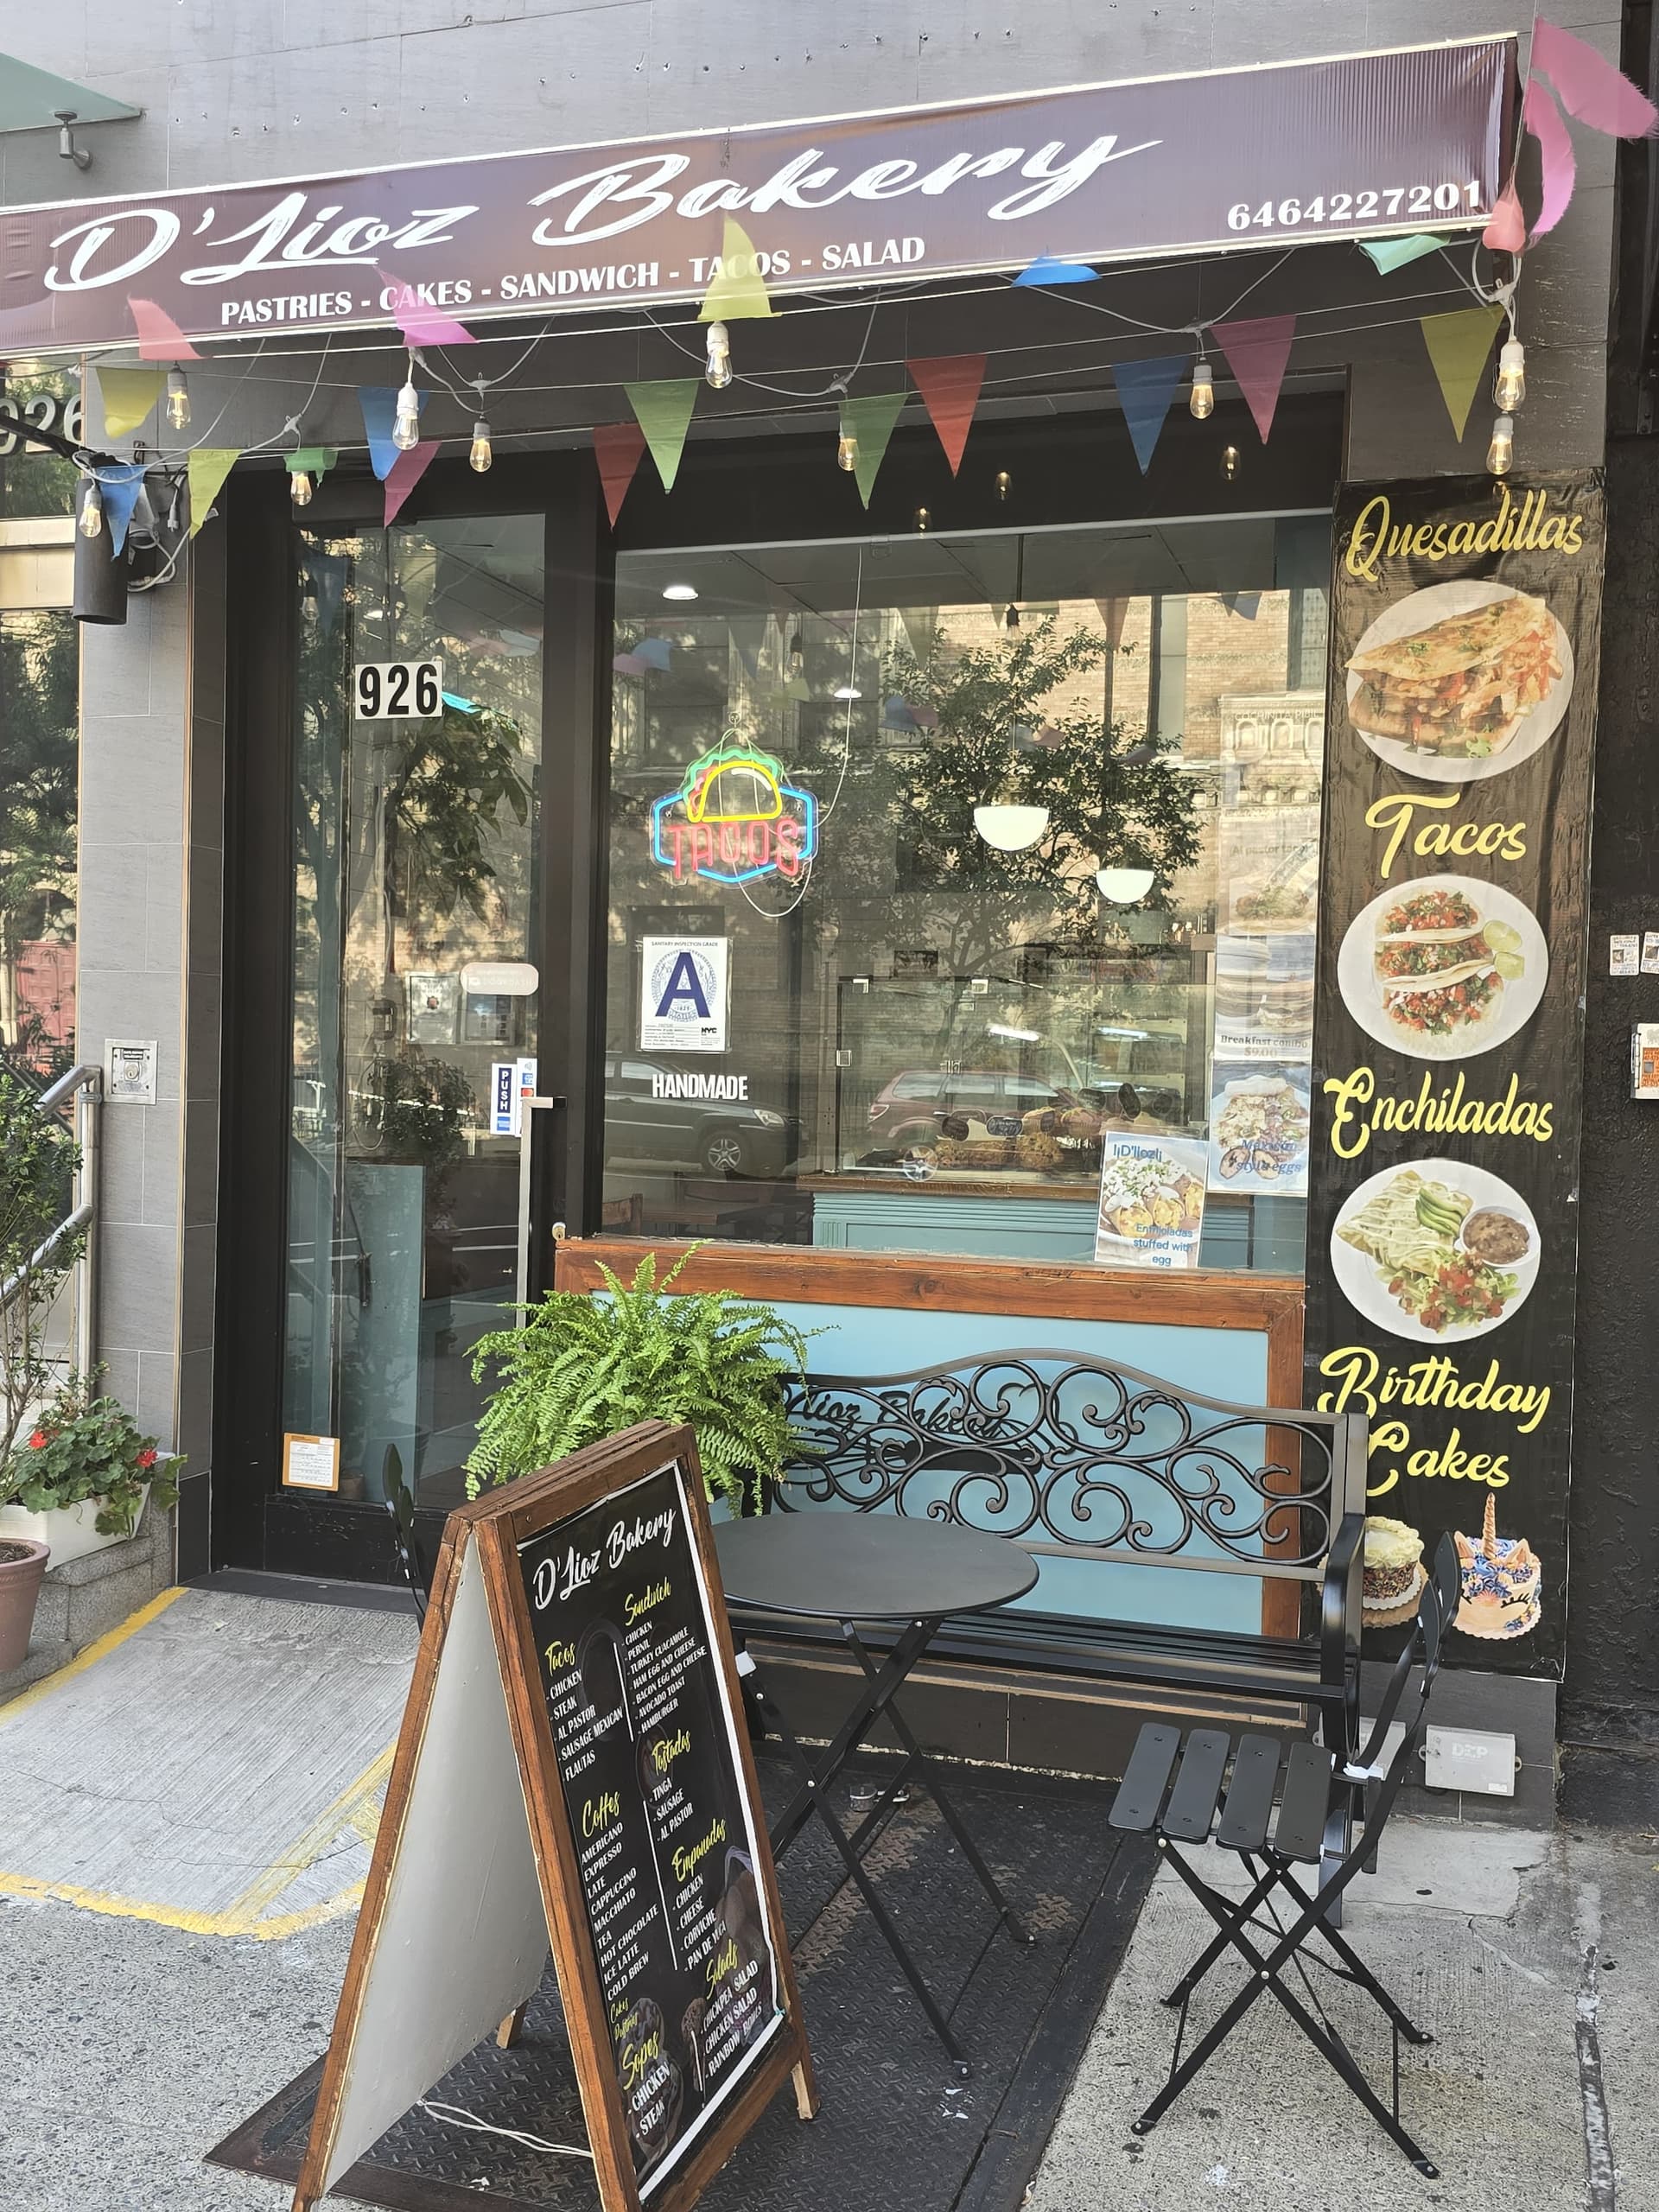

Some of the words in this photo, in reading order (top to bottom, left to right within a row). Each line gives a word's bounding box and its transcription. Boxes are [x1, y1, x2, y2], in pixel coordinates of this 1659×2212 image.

[43, 192, 480, 293] D'Lioz
[527, 136, 1163, 247] Bakery
[1227, 181, 1482, 232] 6464227201
[221, 289, 353, 326] PASTRIES
[378, 279, 472, 311] CAKES
[499, 262, 660, 300] SANDWICH
[689, 251, 790, 286] TACOS
[821, 236, 926, 271] SALAD
[1345, 490, 1584, 582] Quesadillas
[359, 664, 439, 717] 926
[668, 817, 800, 879] TACOS
[1365, 792, 1528, 880] Tacos
[655, 952, 711, 1018] A
[1221, 1034, 1271, 1046] Breakfast
[499, 1071, 509, 1110] PUSH
[652, 1073, 749, 1101] HANDMADE
[1324, 1066, 1554, 1159] Enchiladas
[1272, 1162, 1302, 1175] eggs
[1134, 1238, 1169, 1250] stuffed
[1172, 1242, 1193, 1252] with
[1152, 1255, 1172, 1267] egg
[1317, 1346, 1552, 1433] Birthday
[1366, 1421, 1510, 1497] Cakes
[532, 1546, 601, 1611] D'Lioz
[606, 1508, 677, 1569] Bakery
[625, 1576, 671, 1626] Sandwich
[625, 1620, 652, 1645] CHICKEN
[627, 1638, 651, 1661] PERNIL
[544, 1640, 576, 1677] Tacos
[630, 1650, 654, 1675] TURKEY
[632, 1673, 648, 1689] HAM
[647, 1663, 660, 1679] EGG
[661, 1653, 674, 1669] AND
[673, 1637, 696, 1659] CHEESE
[635, 1681, 657, 1705] BACON
[657, 1672, 671, 1688] EGG
[671, 1662, 683, 1678] AND
[683, 1645, 708, 1668] CHEESE
[550, 1669, 582, 1700] CHICKEN
[639, 1690, 667, 1719] AVOCADO
[666, 1675, 686, 1696] TOAST
[553, 1694, 578, 1721] STEAK
[557, 1723, 569, 1742] AL
[568, 1704, 596, 1734] PASTOR
[641, 1697, 679, 1733] HAMBURGER
[561, 1727, 594, 1761] SAUSAGE
[593, 1706, 624, 1738] MEXICAN
[652, 1728, 690, 1777] Tostadas
[565, 1749, 596, 1783] FLAUTAS
[652, 1777, 673, 1802] TINGA
[656, 1788, 685, 1821] SAUSAGE
[582, 1821, 623, 1865] AMERICANO
[660, 1825, 670, 1842] AL
[669, 1802, 694, 1830] PASTOR
[584, 1841, 622, 1882] EXPRESSO
[671, 1818, 726, 1882] Empanadas
[588, 1875, 606, 1899] LATE
[591, 1867, 637, 1916] CAPPUCCINO
[676, 1873, 704, 1910] CHICKEN
[594, 1887, 636, 1934] MACCHIATO
[679, 1895, 705, 1929] CHEESE
[683, 1908, 717, 1950] CORVICHE
[597, 1929, 613, 1950] TEA
[601, 1944, 617, 1967] HOT
[617, 1904, 659, 1950] CHOCOLATE
[687, 1947, 702, 1971] PAN
[702, 1936, 714, 1955] DE
[603, 1964, 618, 1985] ICE
[617, 1942, 640, 1970] LATTE
[607, 1974, 628, 2001] COLD
[628, 1951, 649, 1980] BREW
[706, 1938, 739, 2000] Salads
[703, 1986, 733, 2032] CHICKPEA
[734, 1960, 759, 1992] SALAD
[705, 2011, 734, 2055] CHICKEN
[733, 1986, 757, 2019] SALAD
[622, 2031, 659, 2091] Sopes
[708, 2029, 741, 2077] RAINBOW
[632, 2061, 671, 2112] CHICKEN
[639, 2096, 665, 2136] STEAK
